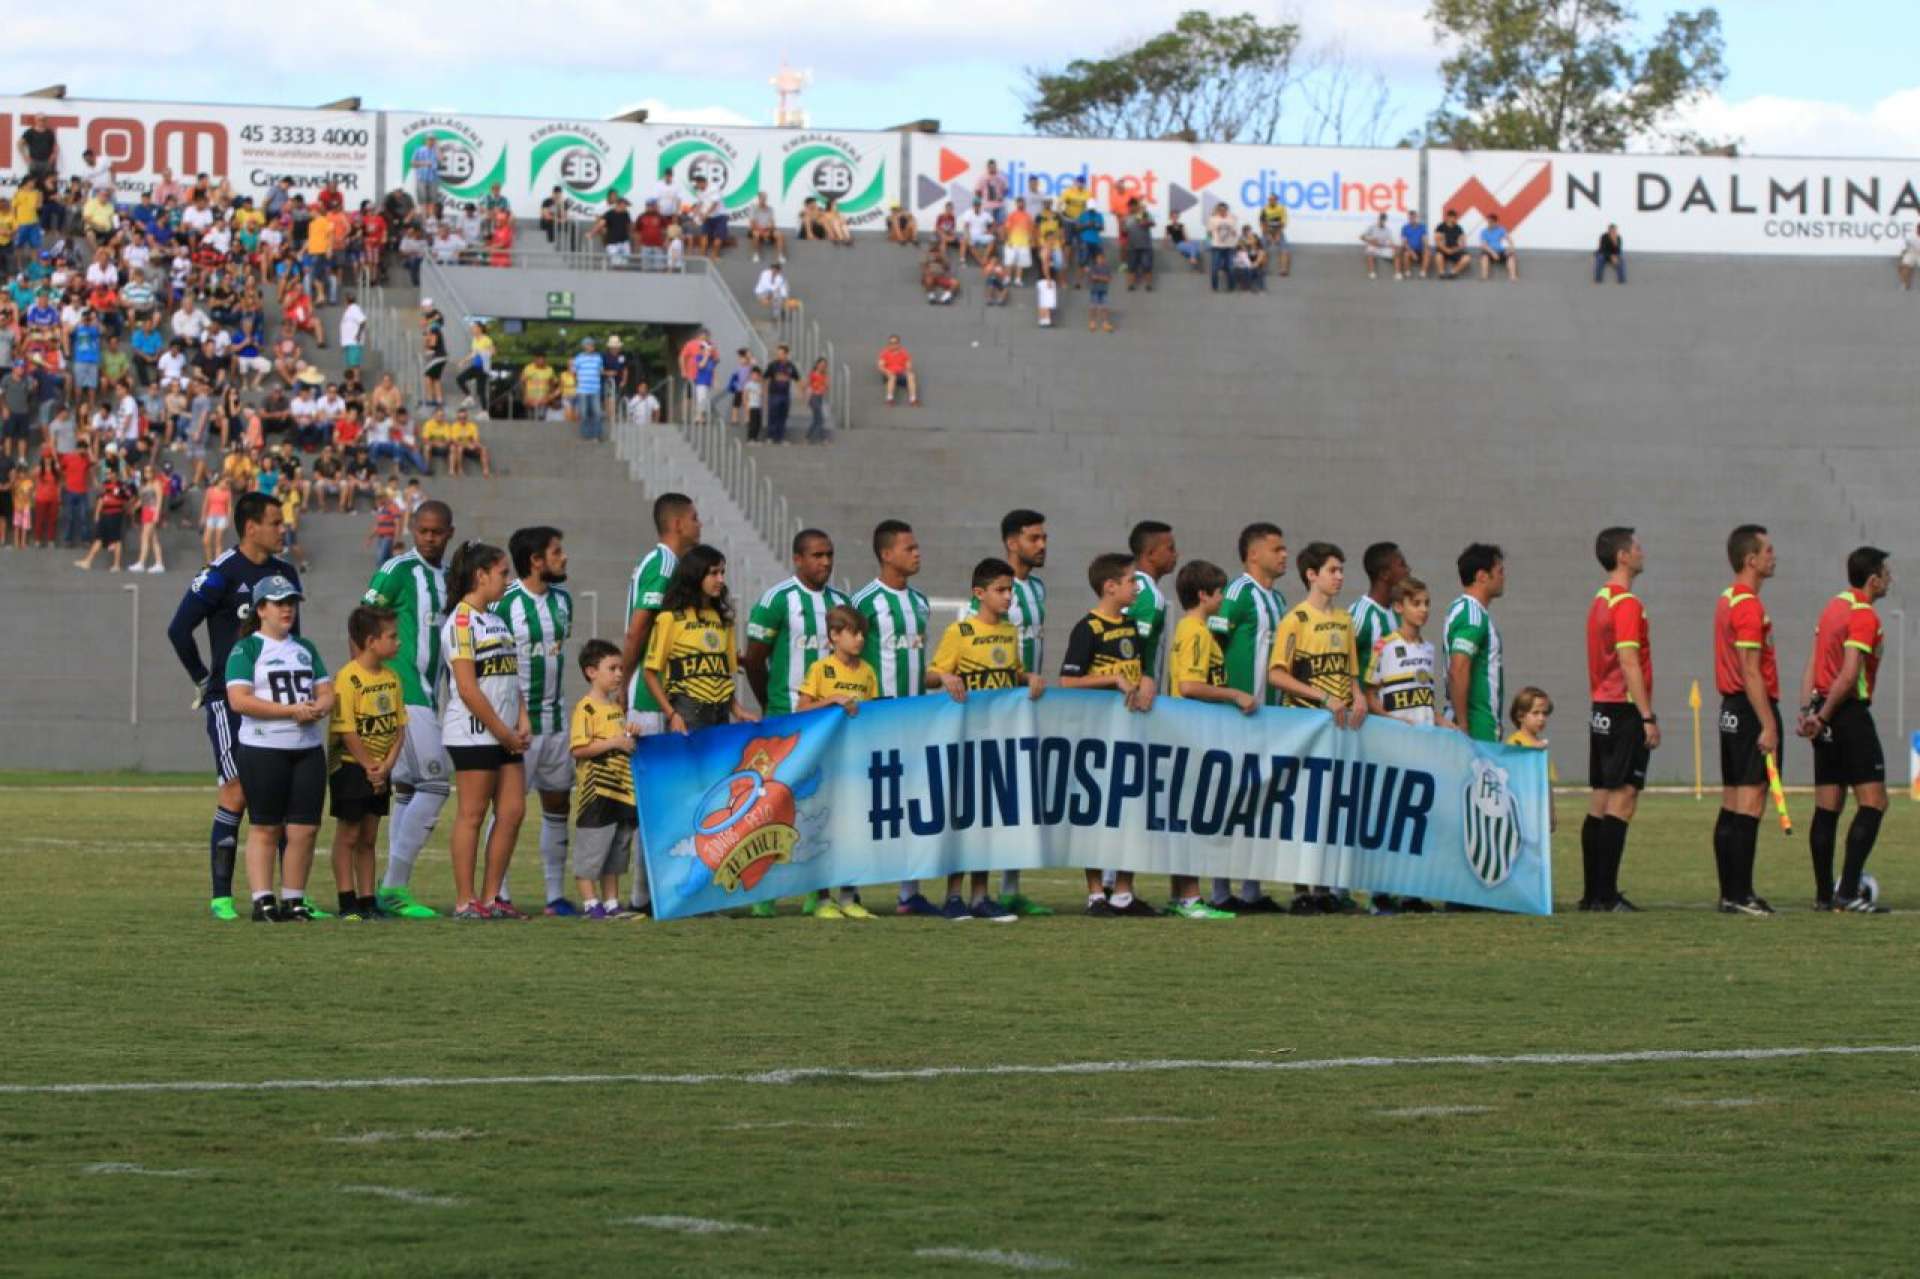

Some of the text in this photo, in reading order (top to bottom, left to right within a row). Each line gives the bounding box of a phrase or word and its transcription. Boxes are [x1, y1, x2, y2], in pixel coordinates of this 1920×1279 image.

[240, 124, 369, 147] 45 3333 4000
[402, 116, 484, 149] EMBALAGENS
[529, 122, 610, 154] EMBALAGENS
[657, 128, 738, 160] EMBALAGENS
[782, 133, 862, 164] EMBALAGENS
[1240, 168, 1409, 213] dipelnet
[1566, 171, 1601, 211] N
[867, 736, 1435, 856] #JUNTOSPELOARTHUR
